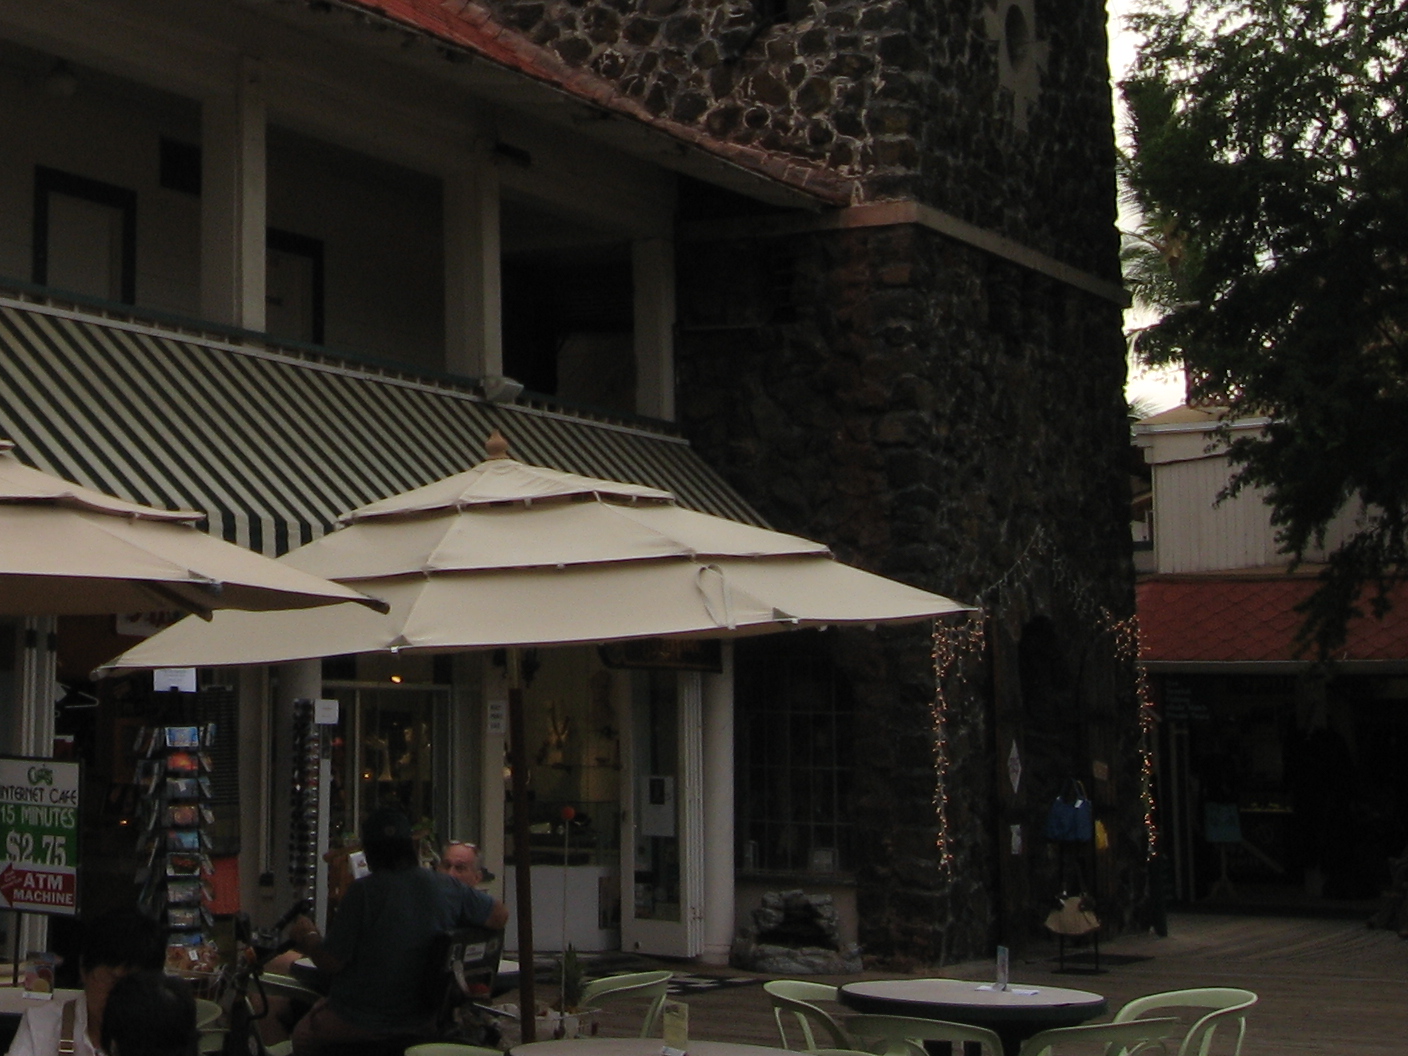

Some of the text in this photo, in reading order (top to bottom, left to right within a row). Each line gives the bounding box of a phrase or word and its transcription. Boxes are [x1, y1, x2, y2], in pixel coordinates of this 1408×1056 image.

[0, 785, 77, 805] INTERNET CAFE
[1, 804, 76, 829] 15 MINUTES
[6, 829, 67, 867] $2.75
[23, 873, 64, 890] ATM
[13, 889, 74, 905] MACHINE
